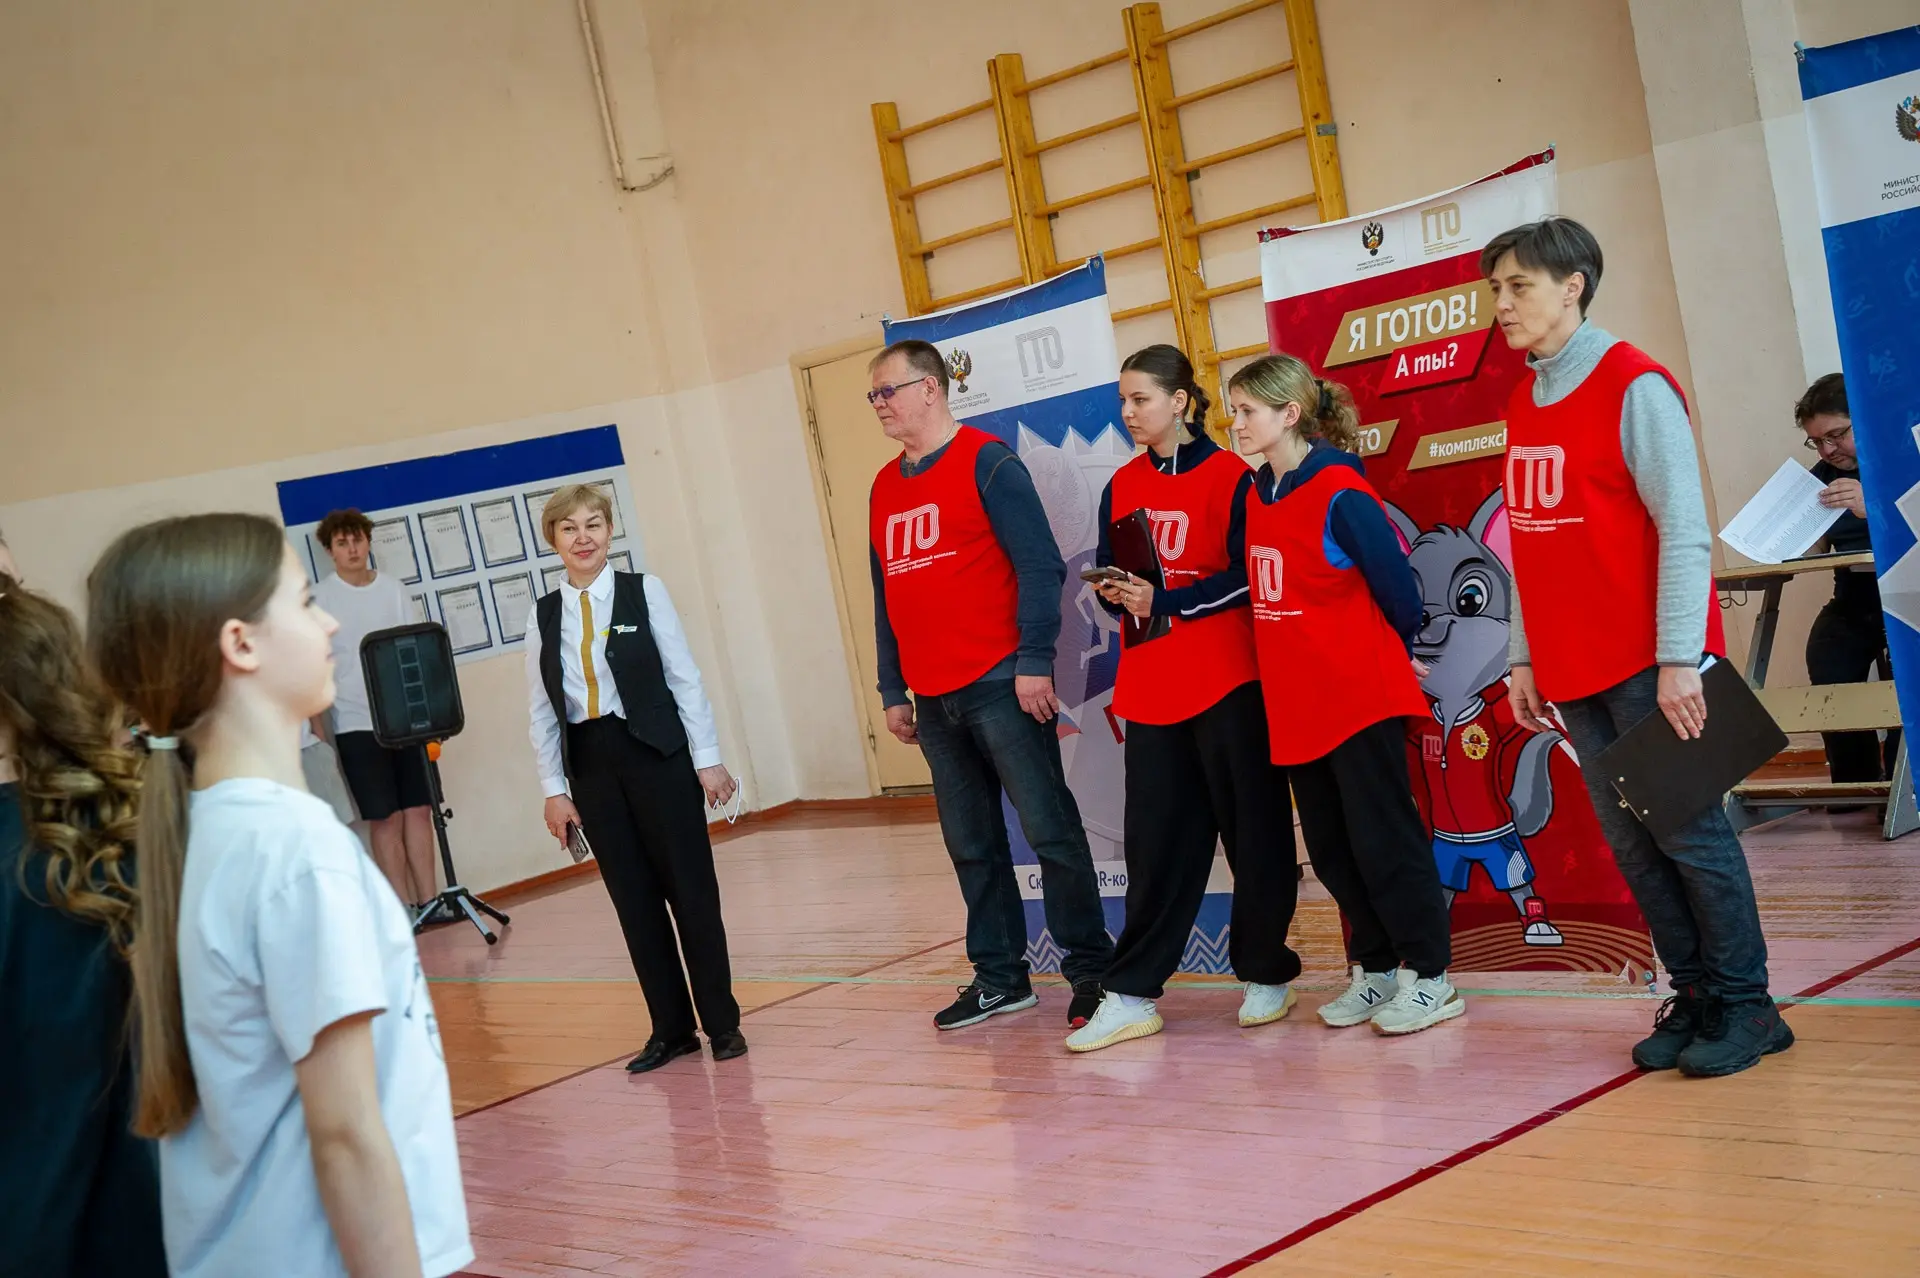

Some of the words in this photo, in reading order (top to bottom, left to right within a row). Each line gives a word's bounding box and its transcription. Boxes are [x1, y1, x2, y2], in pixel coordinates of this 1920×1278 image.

[1881, 184, 1920, 201] РОССИЙС
[1883, 175, 1920, 190] МИНИСТ
[1421, 202, 1461, 243] ГТО
[1348, 317, 1366, 353] Я
[1376, 290, 1477, 347] ГОТОВ!
[1014, 325, 1066, 378] ГТО
[1395, 353, 1409, 379] А
[1413, 342, 1458, 375] ты?
[1506, 444, 1565, 509] ГТО
[886, 503, 940, 561] ГТО
